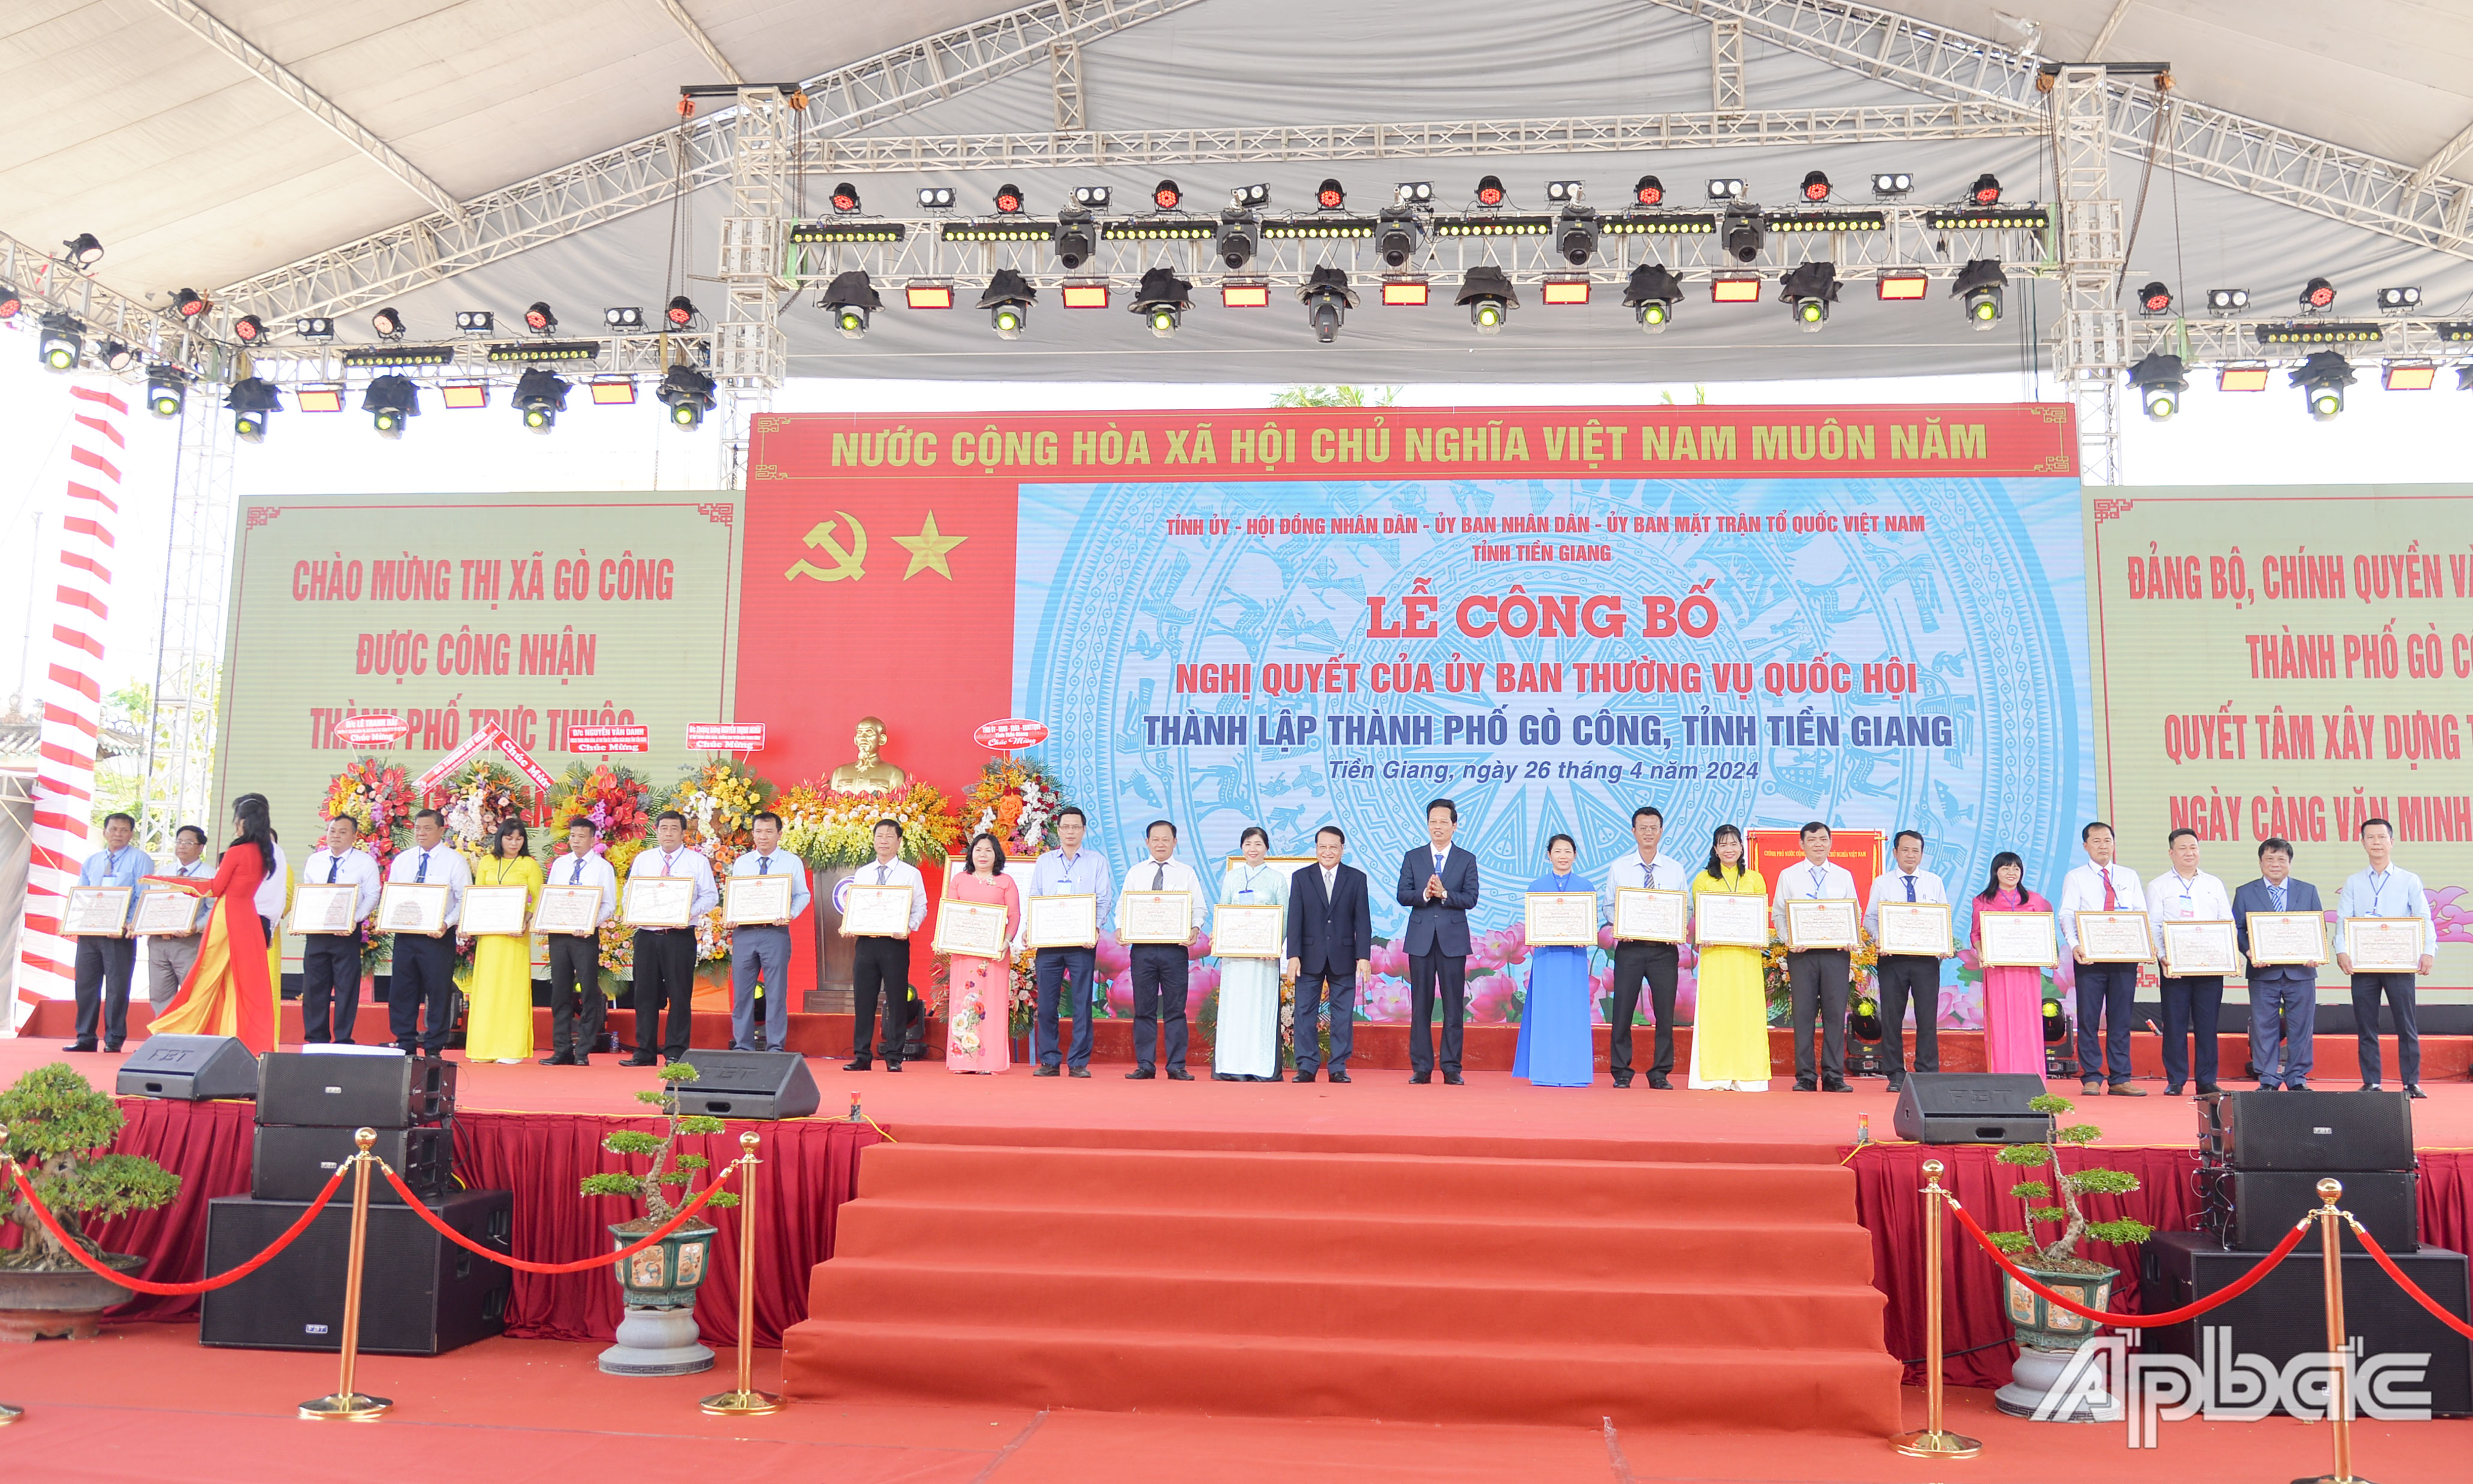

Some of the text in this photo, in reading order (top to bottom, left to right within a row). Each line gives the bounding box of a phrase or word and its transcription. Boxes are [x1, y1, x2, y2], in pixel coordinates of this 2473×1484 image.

[833, 417, 1986, 473] NƯỚC CỘNG HÒA XÃ HỘI CHỦ NGHĨA VIỆT NAM MUÔN NĂM
[1167, 514, 1204, 535] TỈNH
[1210, 514, 1230, 535] ỦY
[1247, 515, 1274, 538] HỘI
[1280, 513, 1325, 534] ĐỒNG
[1331, 514, 1378, 533] NHÂN
[1384, 514, 1418, 533] DÂN
[1435, 512, 1456, 533] ỦY
[1462, 517, 1496, 532] BAN
[1503, 514, 1549, 532] NHÂN
[1555, 513, 1590, 532] DÂN
[1608, 511, 1628, 532] ỦY
[1634, 517, 1669, 532] BAN
[1675, 514, 1711, 536] MẶT
[1717, 513, 1760, 536] TRẬN
[1767, 509, 1787, 532] TỔ
[1793, 512, 1838, 534] QUỐC
[1844, 513, 1879, 536] VIỆT
[1885, 515, 1925, 532] NAM
[1473, 540, 1611, 562] TỈNH TIỀN GIANG
[293, 549, 674, 610] CHÀO MỪNG THỊ XÃ GÒ CÔNG
[2128, 540, 2473, 609] ĐẢNG BỘ, CHÍNH QUYỀN V
[1367, 577, 1718, 638] LỄ CÔNG BỐ
[357, 625, 596, 684] ĐƯỢC CÔNG NHẬN
[1177, 652, 1916, 700] NGHỊ QUYẾT CỦA ỦY BAN THƯỜNG VỤ QUỐC HỘI
[2246, 625, 2336, 678] THÀNH
[2344, 619, 2398, 678] PHỐ
[2407, 623, 2444, 678] GÒ
[405, 693, 462, 750] PHỐ
[1144, 704, 1952, 753] THÀNH LẬP THÀNH PHỐ GÒ CÔNG, TỈNH TIỀN GIANG
[2165, 700, 2247, 765] QUYẾT
[2255, 705, 2315, 759] TÂM
[2324, 705, 2374, 759] XÂY
[2384, 710, 2460, 770] DỰNG
[501, 740, 528, 767] Chúc
[1330, 756, 1759, 783] Tiền Giang, ngày 26 tháng 4 năm 2024
[2170, 786, 2242, 841] NGÀY
[2252, 786, 2327, 841] CÀNG
[2398, 796, 2472, 841] MINH
